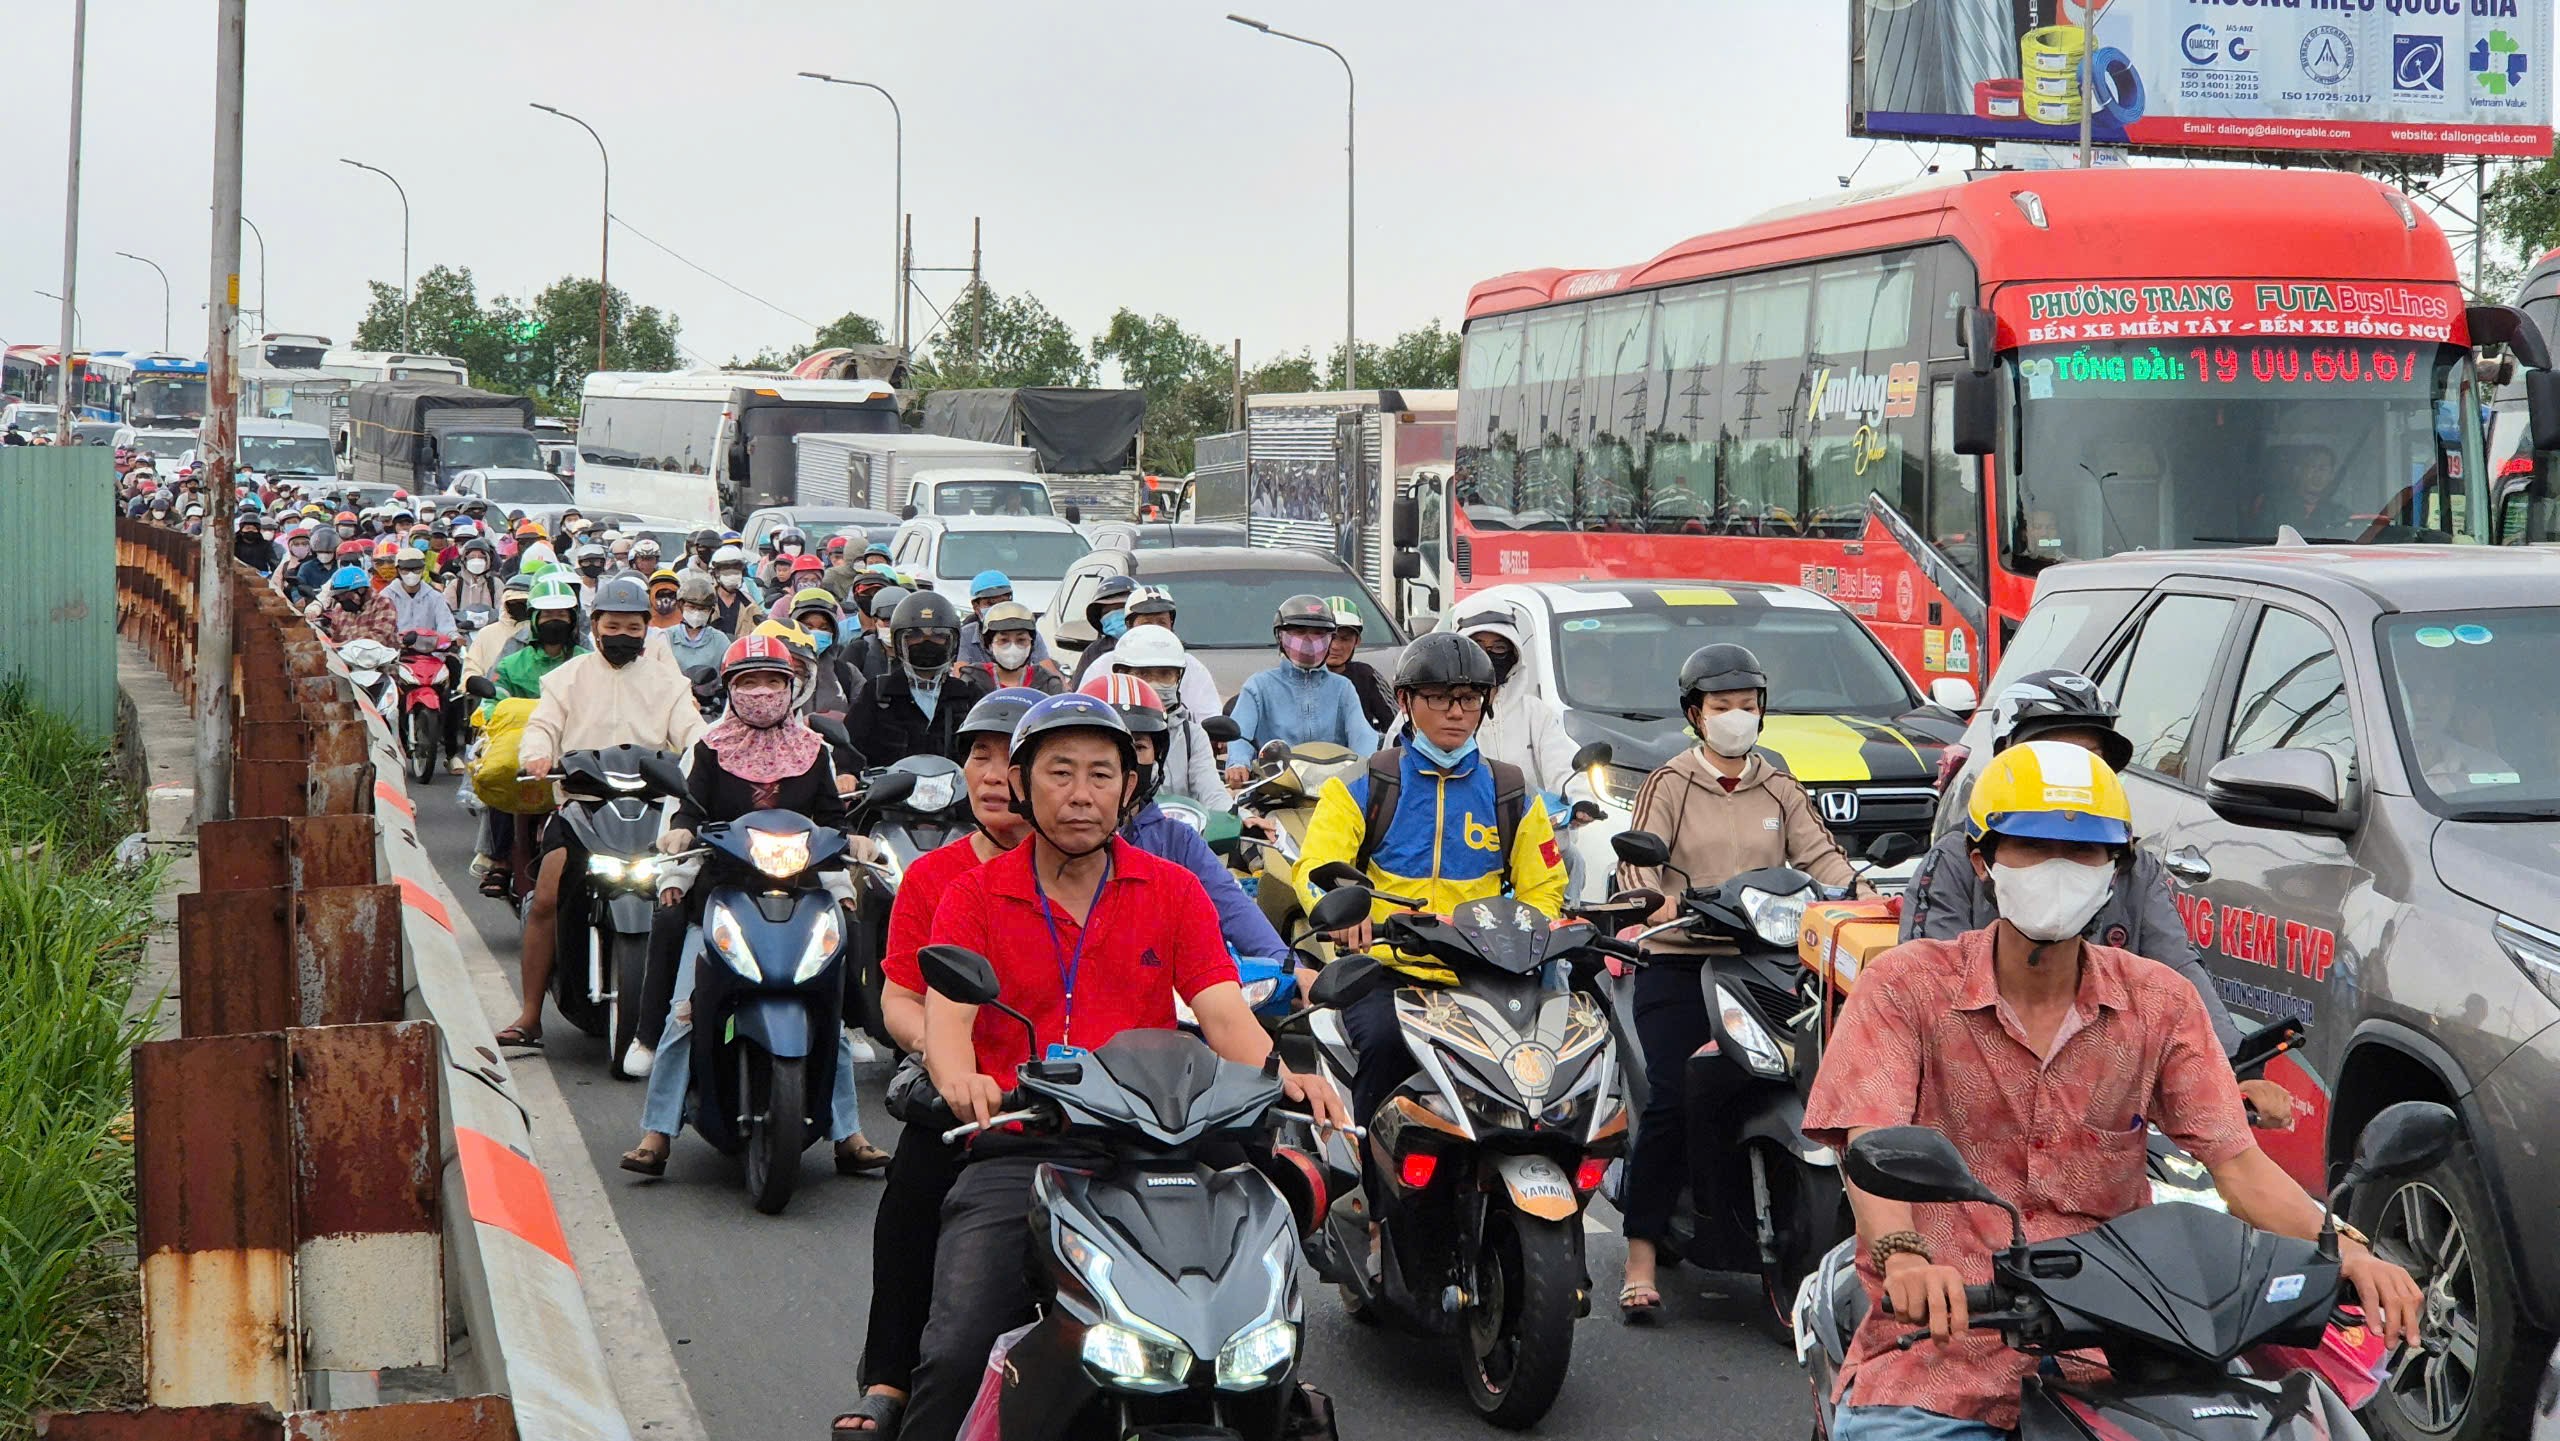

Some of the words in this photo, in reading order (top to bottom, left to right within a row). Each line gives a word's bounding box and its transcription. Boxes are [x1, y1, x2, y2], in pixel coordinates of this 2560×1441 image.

[2189, 38, 2219, 50] QUACERT
[2206, 73, 2259, 81] 9001:2015
[2201, 82, 2259, 90] 14001:2015
[2201, 91, 2259, 99] 45001:2018
[2282, 92, 2302, 100] ISO
[2305, 92, 2372, 103] 17025:2017
[2470, 97, 2503, 107] Vietnam
[2506, 99, 2527, 107] Value
[2183, 122, 2215, 133] Email:
[2391, 129, 2437, 140] website:
[2440, 130, 2537, 144] dailongcable.com
[2029, 284, 2139, 320] PHƯƠNG
[2142, 284, 2234, 313] TRANG
[2255, 284, 2338, 312] FUTA
[2028, 320, 2076, 342] BẾN
[2082, 322, 2115, 338] XE
[2120, 315, 2180, 337] MIỀN
[2185, 316, 2234, 334] TÂY
[2259, 313, 2304, 334] BẾN
[2310, 319, 2340, 334] XE
[2344, 313, 2404, 336] HỒNG
[2054, 344, 2127, 383] TỔNG
[2166, 879, 2214, 949] NG
[2284, 919, 2336, 983] TVP
[1147, 1176, 1198, 1187] HONDA
[1521, 1185, 1572, 1200] YAMAHA
